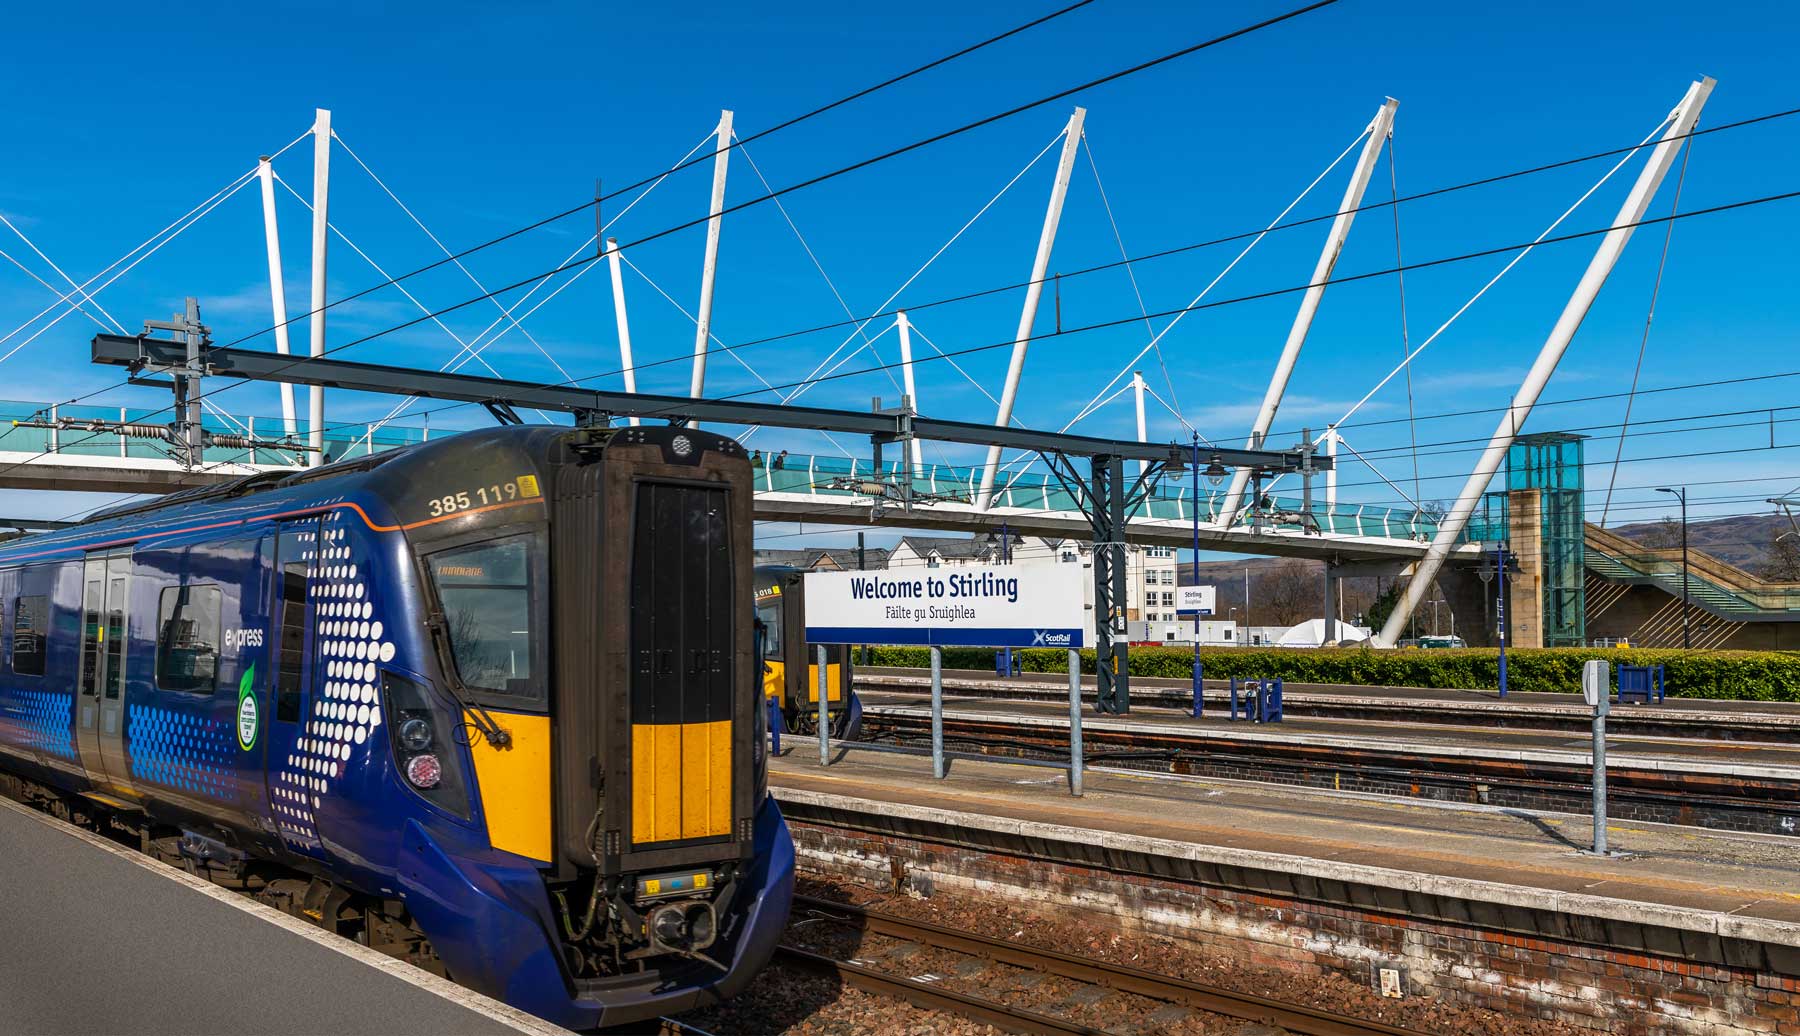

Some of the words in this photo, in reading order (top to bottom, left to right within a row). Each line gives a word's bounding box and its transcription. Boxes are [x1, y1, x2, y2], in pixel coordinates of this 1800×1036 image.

[428, 491, 471, 517] 385
[476, 483, 517, 505] 119
[851, 576, 922, 600] Welcome
[927, 576, 945, 598] to
[949, 572, 1018, 603] Stirling
[886, 605, 911, 619] Fàilte
[914, 609, 926, 622] gu
[929, 605, 976, 622] Sruighlea
[225, 628, 263, 652] express
[1045, 633, 1071, 642] ScotRail
